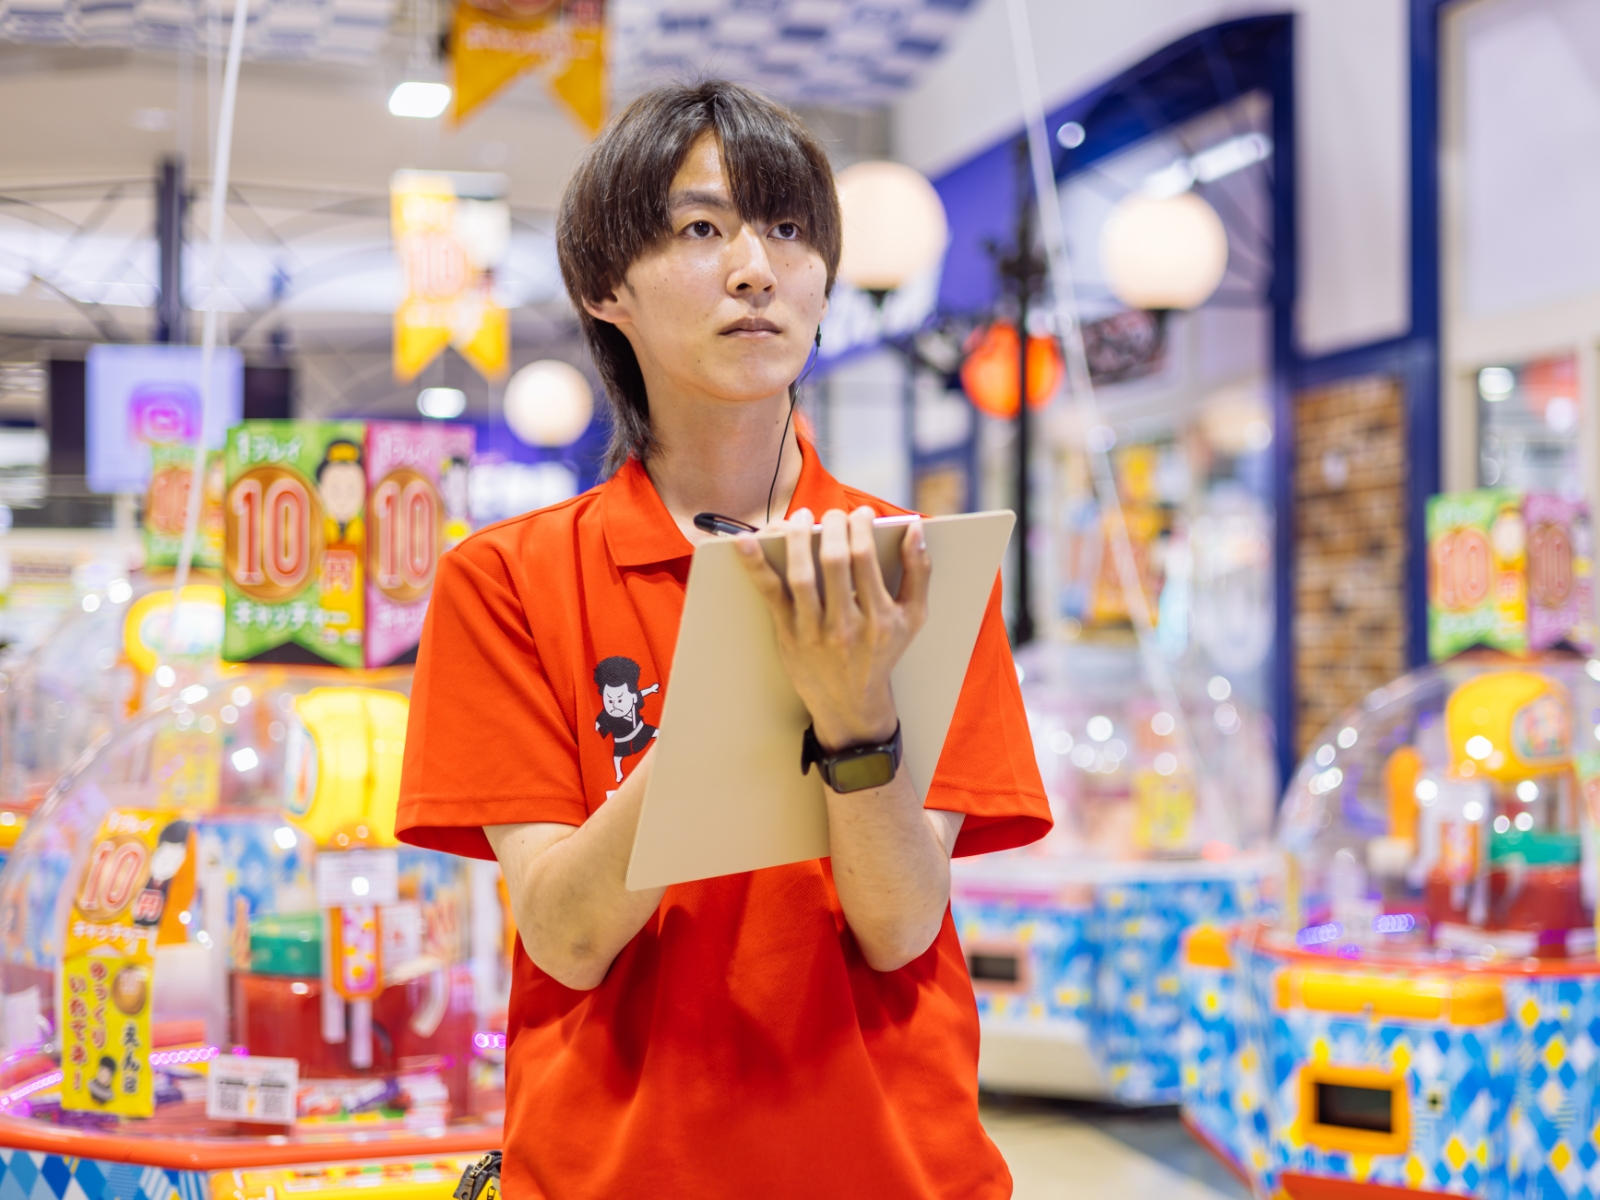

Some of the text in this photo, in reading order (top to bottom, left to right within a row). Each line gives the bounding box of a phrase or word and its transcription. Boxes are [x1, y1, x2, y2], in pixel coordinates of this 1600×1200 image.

[232, 478, 311, 588] 10
[373, 479, 438, 590] 10
[78, 840, 147, 912] 10
